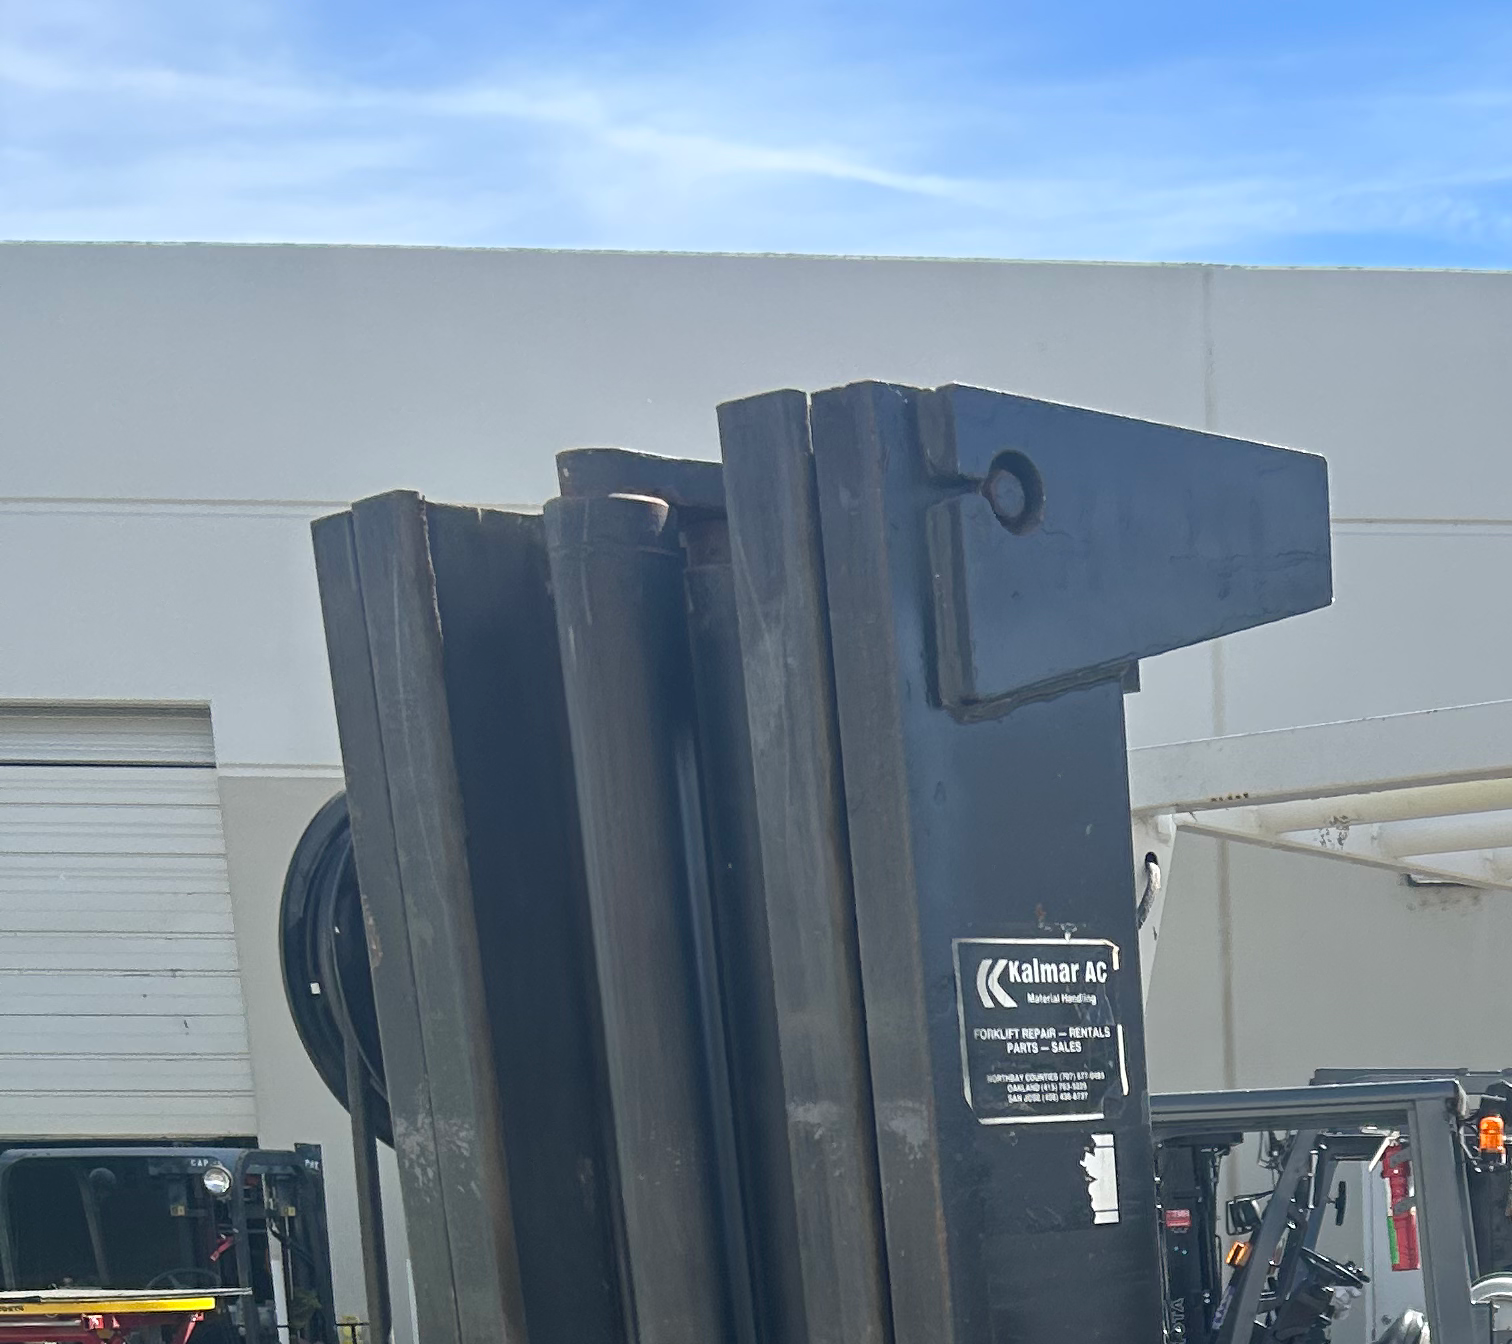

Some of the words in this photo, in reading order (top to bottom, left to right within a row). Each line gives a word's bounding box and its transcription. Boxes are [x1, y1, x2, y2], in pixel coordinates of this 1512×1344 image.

[1008, 957, 1080, 983] Kalmar
[1084, 960, 1108, 983] AC
[1026, 992, 1060, 1004] Material
[1061, 993, 1097, 1006] Handling
[973, 1028, 1020, 1040] FORKLIFT
[1021, 1027, 1057, 1039] REPAIR
[1068, 1026, 1111, 1038] RENTALS
[1006, 1041, 1039, 1054] PARTS
[1051, 1041, 1082, 1053] SALES
